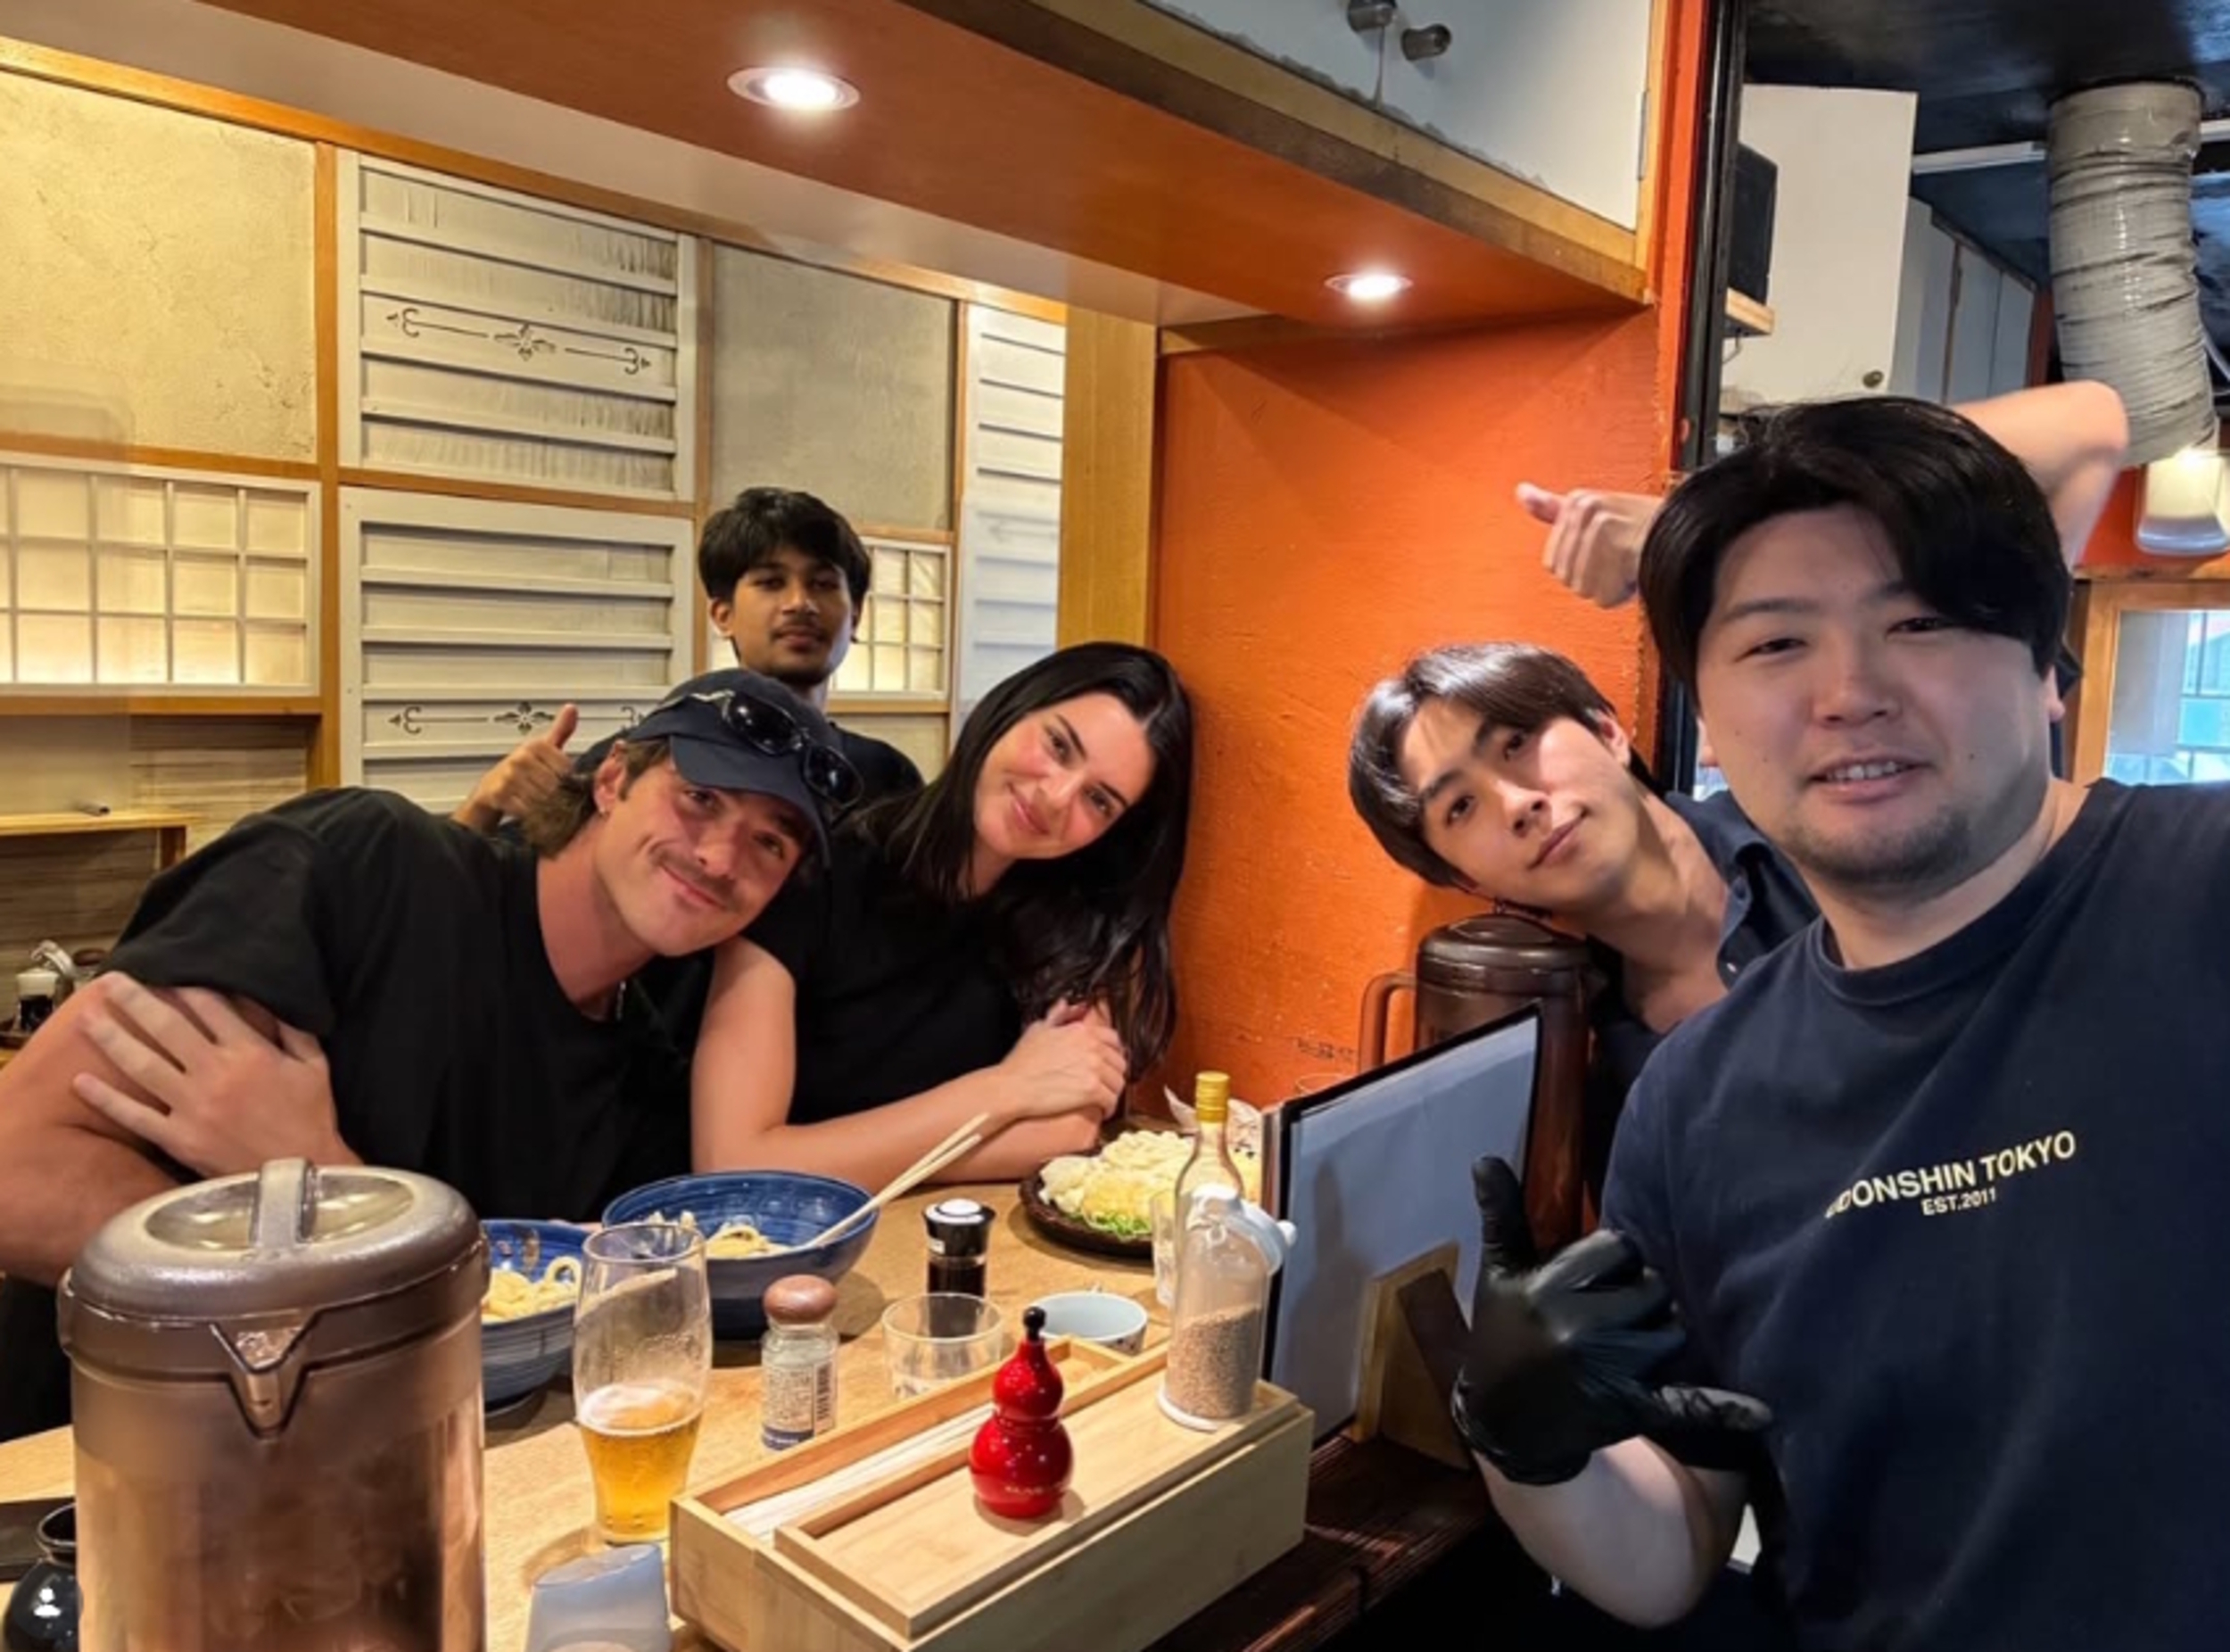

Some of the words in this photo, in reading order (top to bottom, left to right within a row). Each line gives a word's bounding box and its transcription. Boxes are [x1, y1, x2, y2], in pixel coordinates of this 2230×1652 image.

[1825, 1161, 1977, 1218] DONSHIN
[1979, 1130, 2077, 1182] TOKYO
[1920, 1186, 1996, 1216] EST.2011
